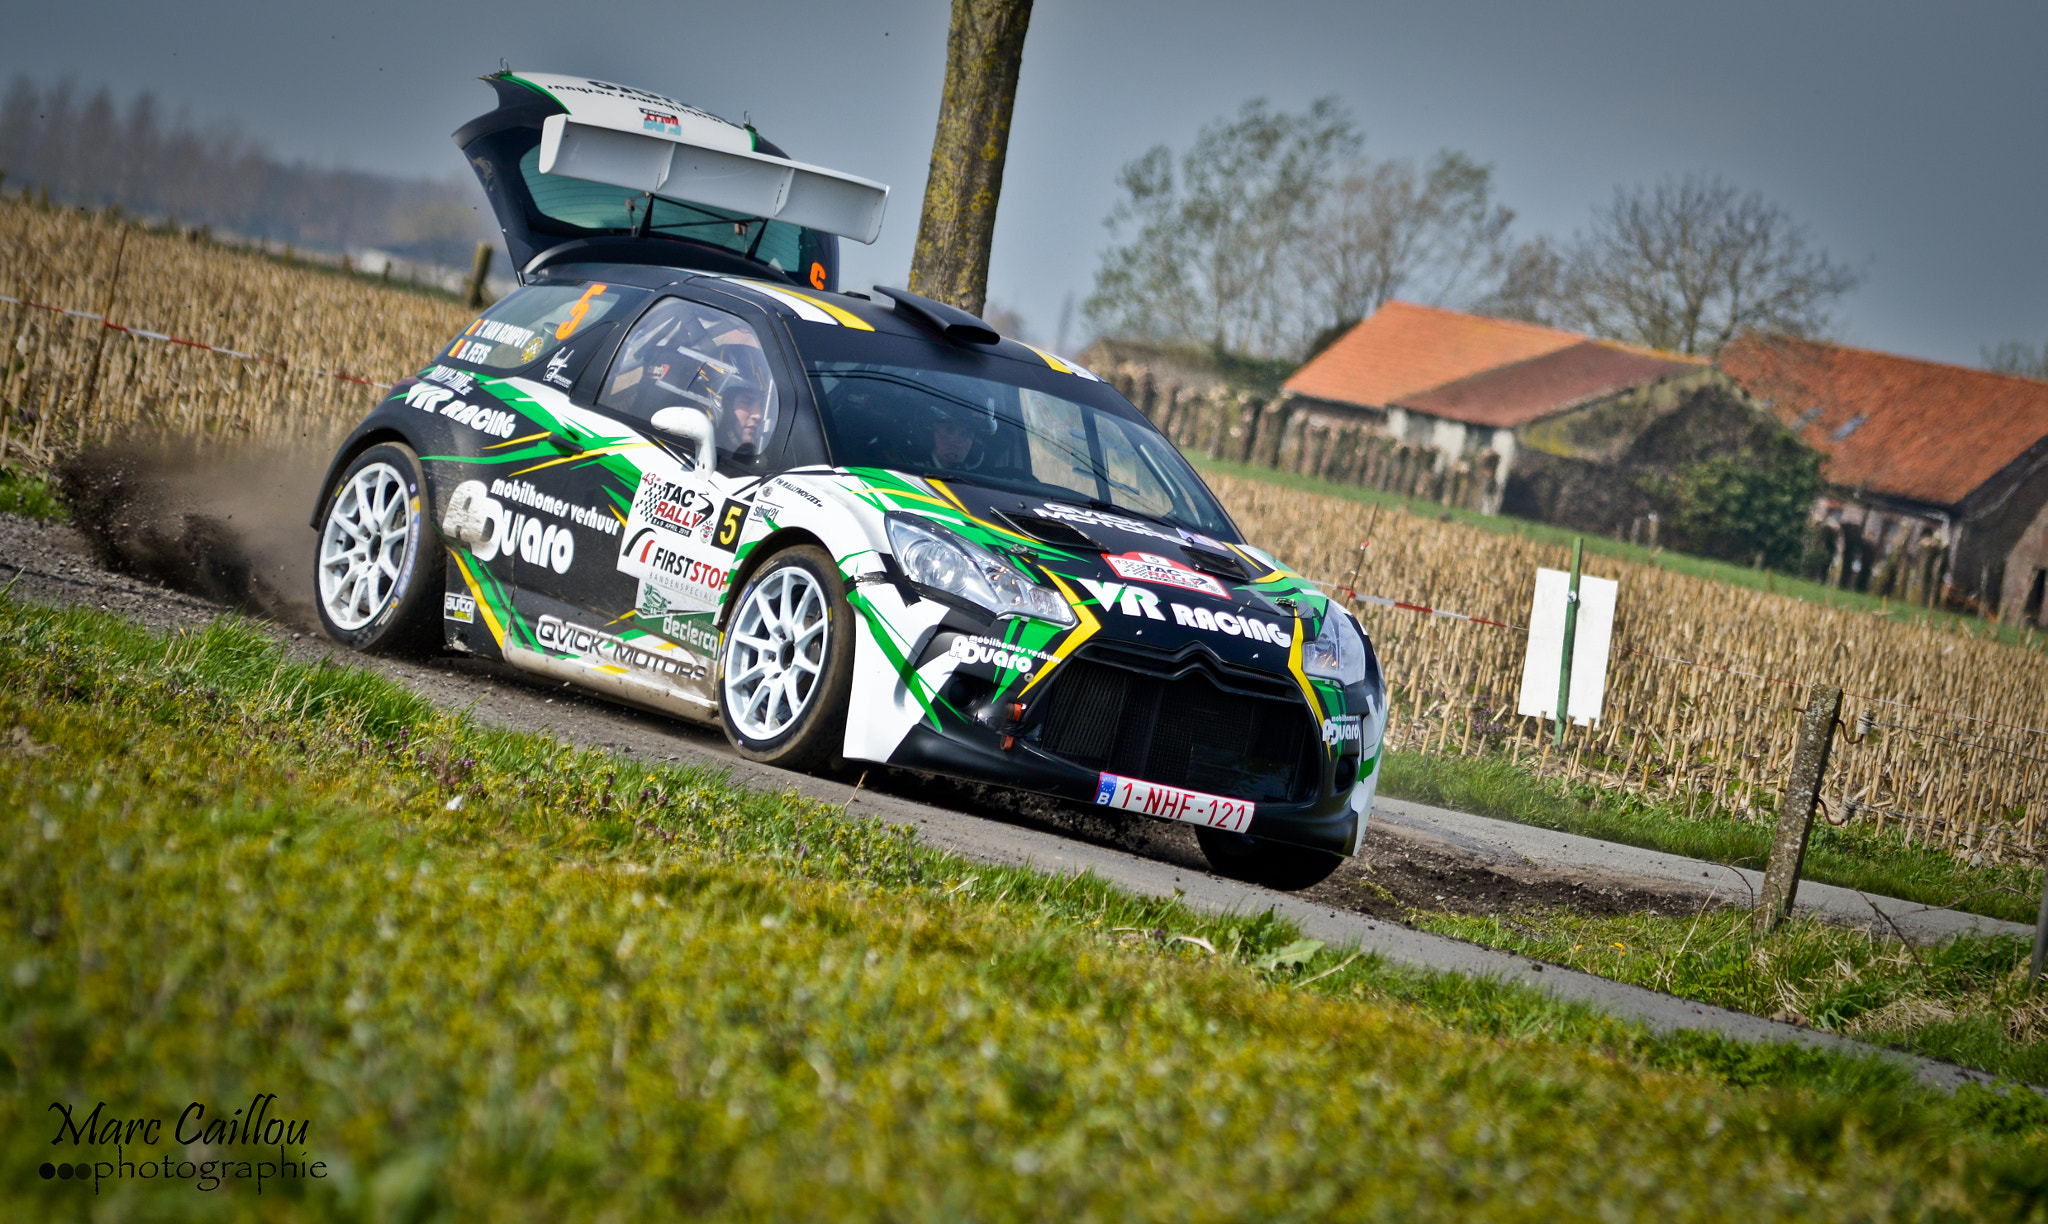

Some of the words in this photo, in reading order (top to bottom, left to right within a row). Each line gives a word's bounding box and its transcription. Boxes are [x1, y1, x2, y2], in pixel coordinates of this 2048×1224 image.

[555, 284, 607, 340] 5
[405, 382, 454, 413] VR
[440, 400, 516, 439] RACING
[490, 478, 570, 518] mobilhomes
[569, 503, 621, 536] verhuur
[663, 481, 696, 508] TAC
[654, 501, 703, 529] RALLY
[719, 505, 742, 545] 5
[1143, 563, 1182, 577] TAC
[1077, 577, 1166, 622] VR
[1170, 602, 1292, 648] RACING
[613, 643, 707, 681] MOTORS
[969, 634, 1026, 654] mobilhomes
[1027, 648, 1063, 665] verhuur
[1097, 792, 1110, 805] B
[1122, 782, 1245, 831] 1-NHF-121
